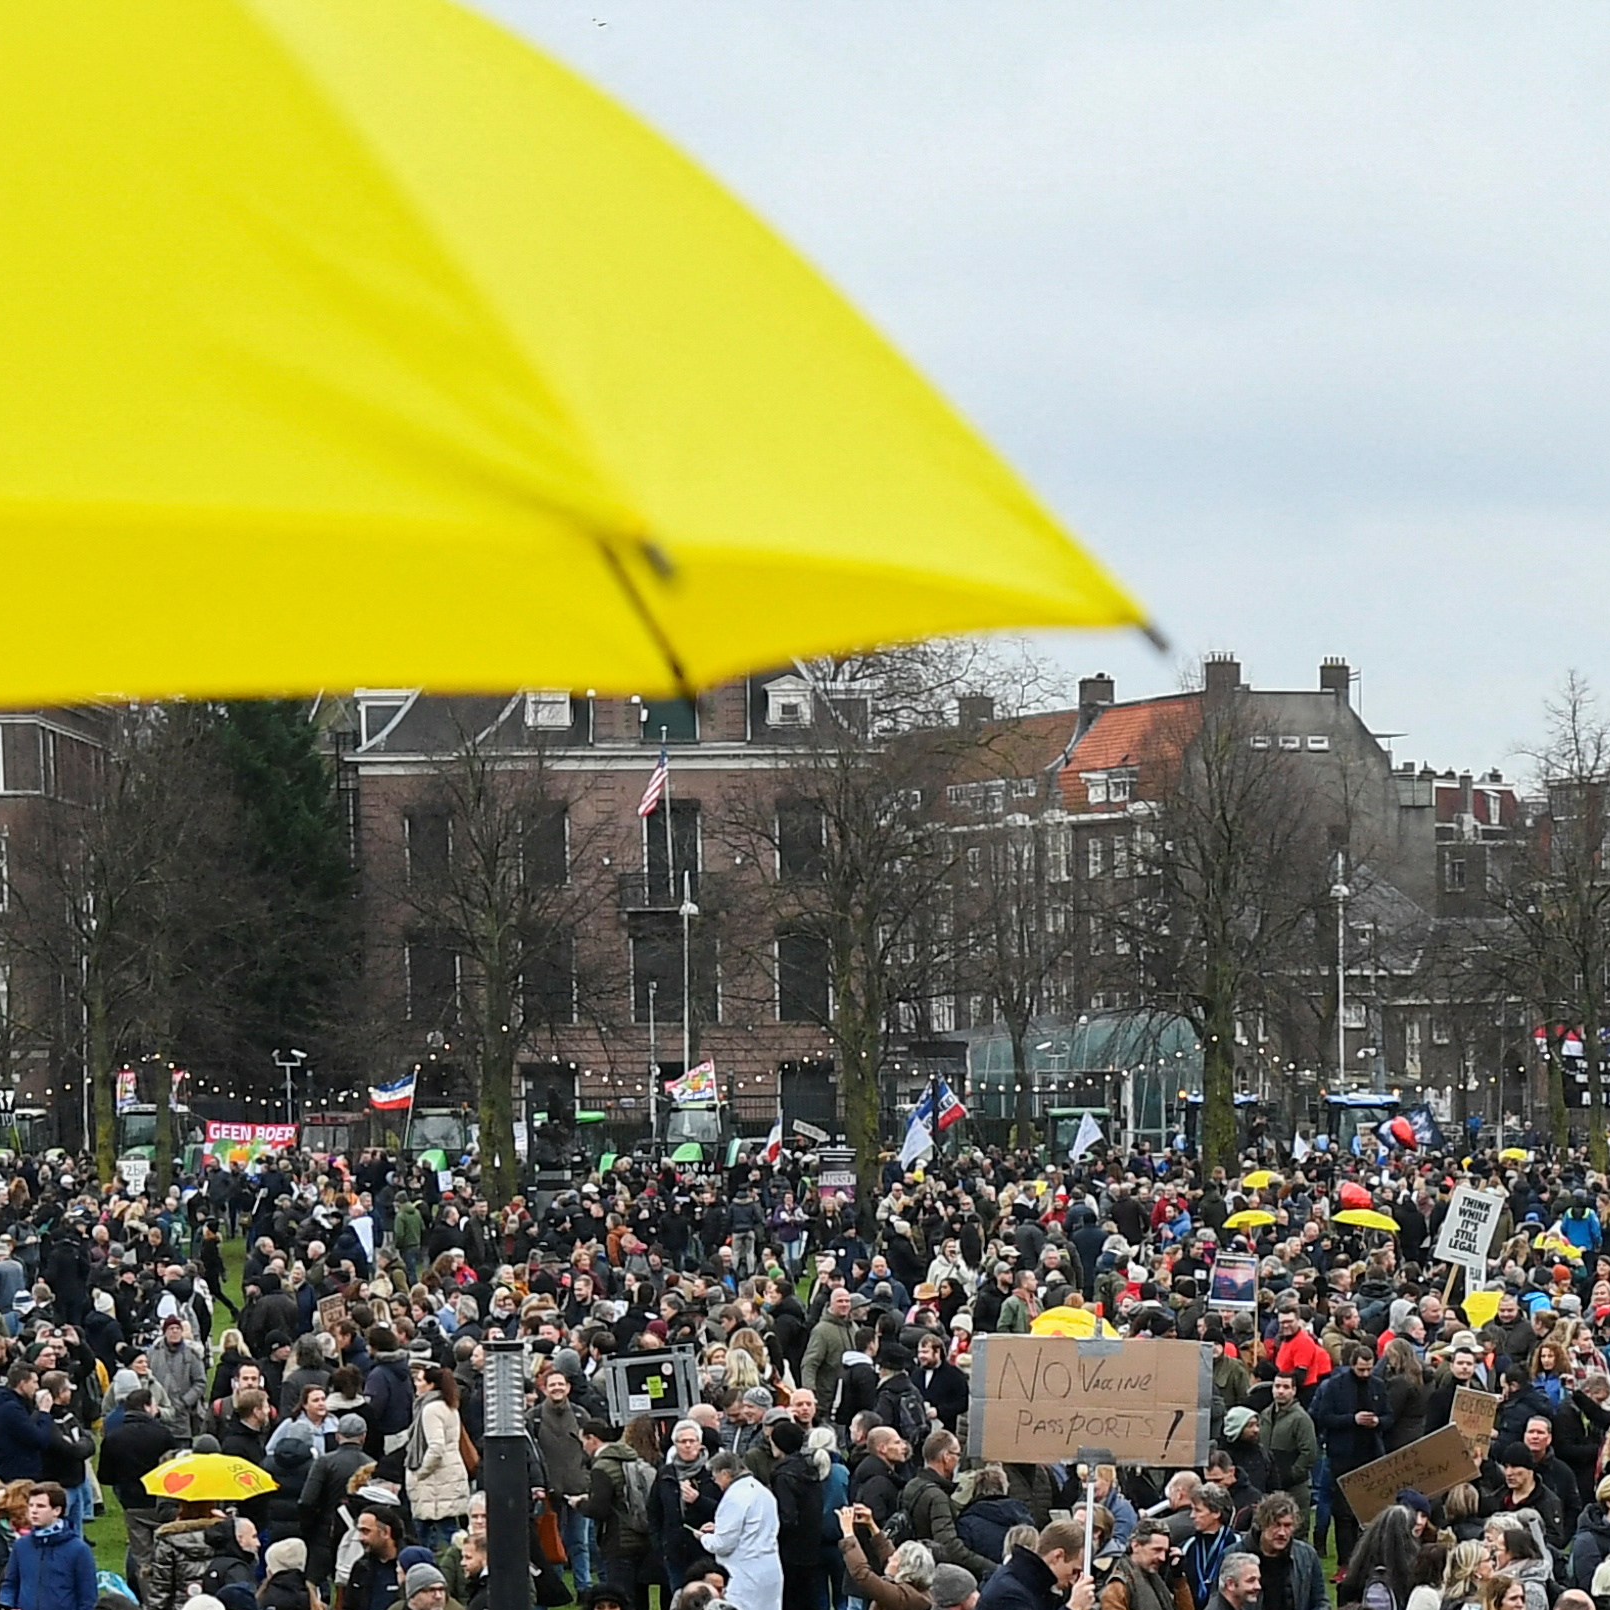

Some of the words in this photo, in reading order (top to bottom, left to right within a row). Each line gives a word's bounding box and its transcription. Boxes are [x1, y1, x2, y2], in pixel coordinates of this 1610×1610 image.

[209, 1123, 252, 1140] GEEN
[1462, 1196, 1493, 1213] THINK
[1458, 1206, 1489, 1223] WHILE
[1461, 1219, 1479, 1232] IT'S
[1454, 1229, 1478, 1243] STILL
[1448, 1238, 1481, 1256] LEGAL.
[998, 1347, 1072, 1403] NO
